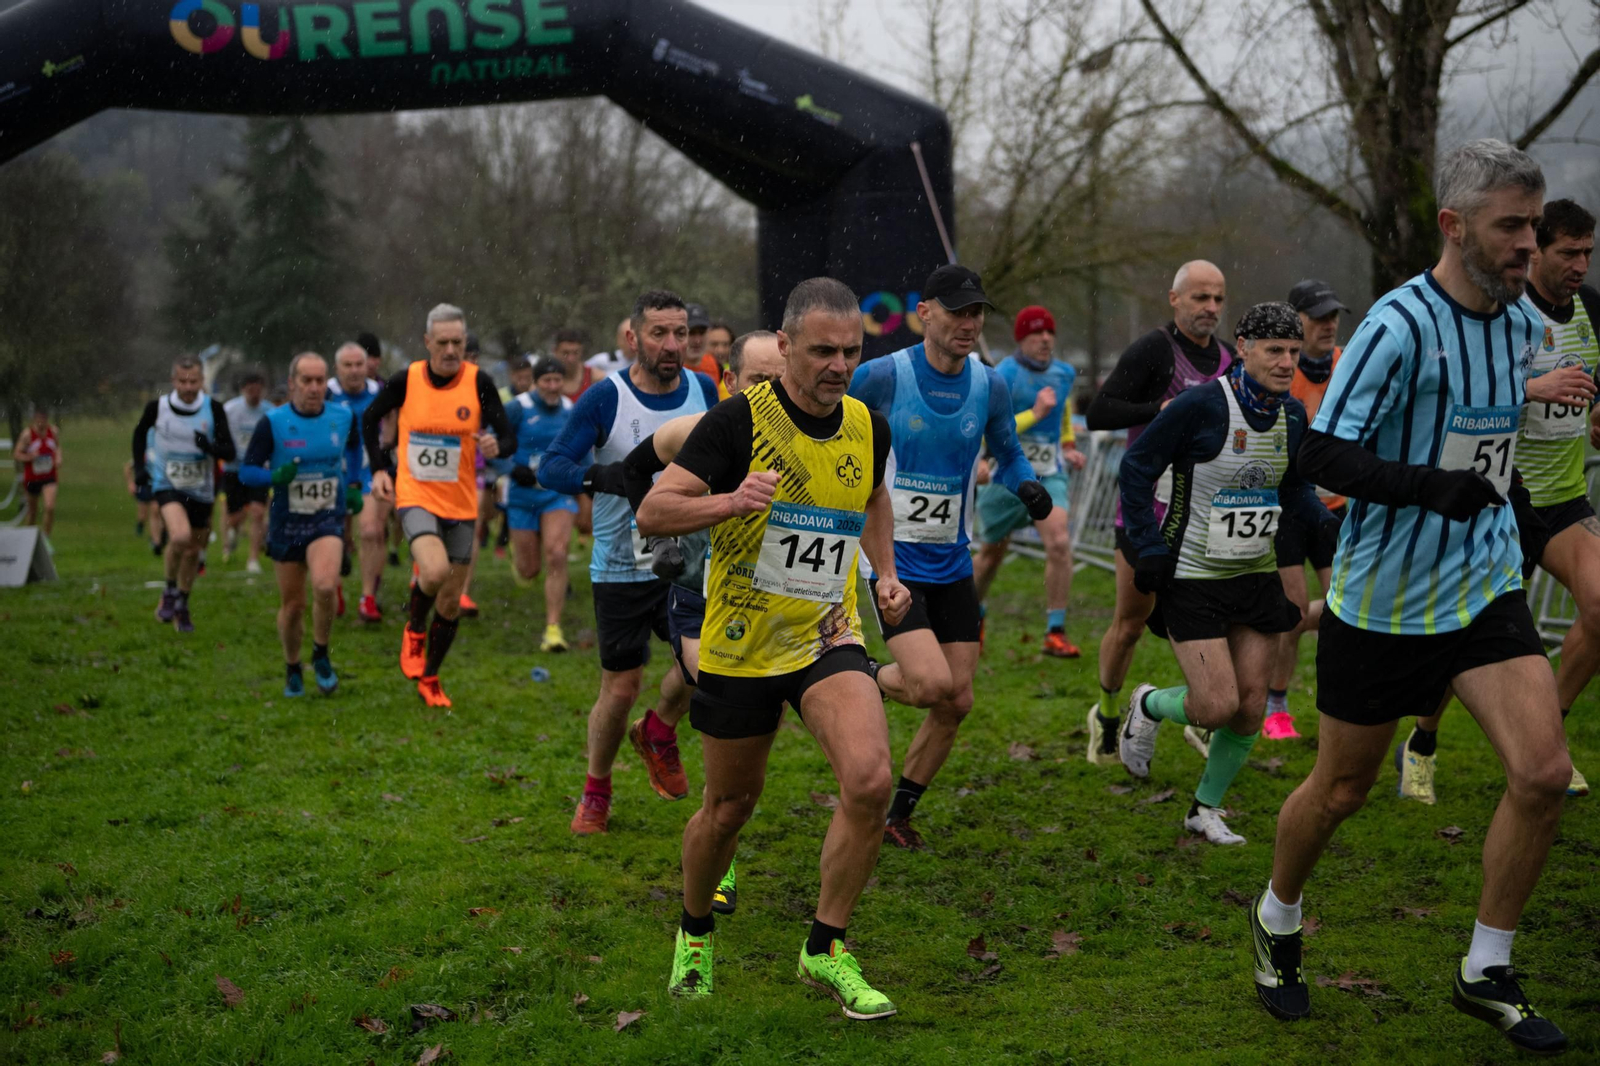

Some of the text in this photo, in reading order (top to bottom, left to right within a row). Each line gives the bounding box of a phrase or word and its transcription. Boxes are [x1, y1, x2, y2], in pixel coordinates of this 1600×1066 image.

[169, 0, 574, 61] OURENSE
[429, 53, 572, 86] NATURAL
[1452, 415, 1511, 430] RIBADAVIA
[418, 448, 448, 467] 68
[1470, 438, 1511, 477] 51
[293, 481, 332, 500] 148
[895, 477, 948, 492] RIBADAVIA
[907, 496, 951, 524] 24
[1213, 495, 1263, 505] RIBADAVIA
[770, 510, 862, 532] RIBADAVIA 2026
[1221, 511, 1273, 538] 132
[779, 534, 846, 575] 141
